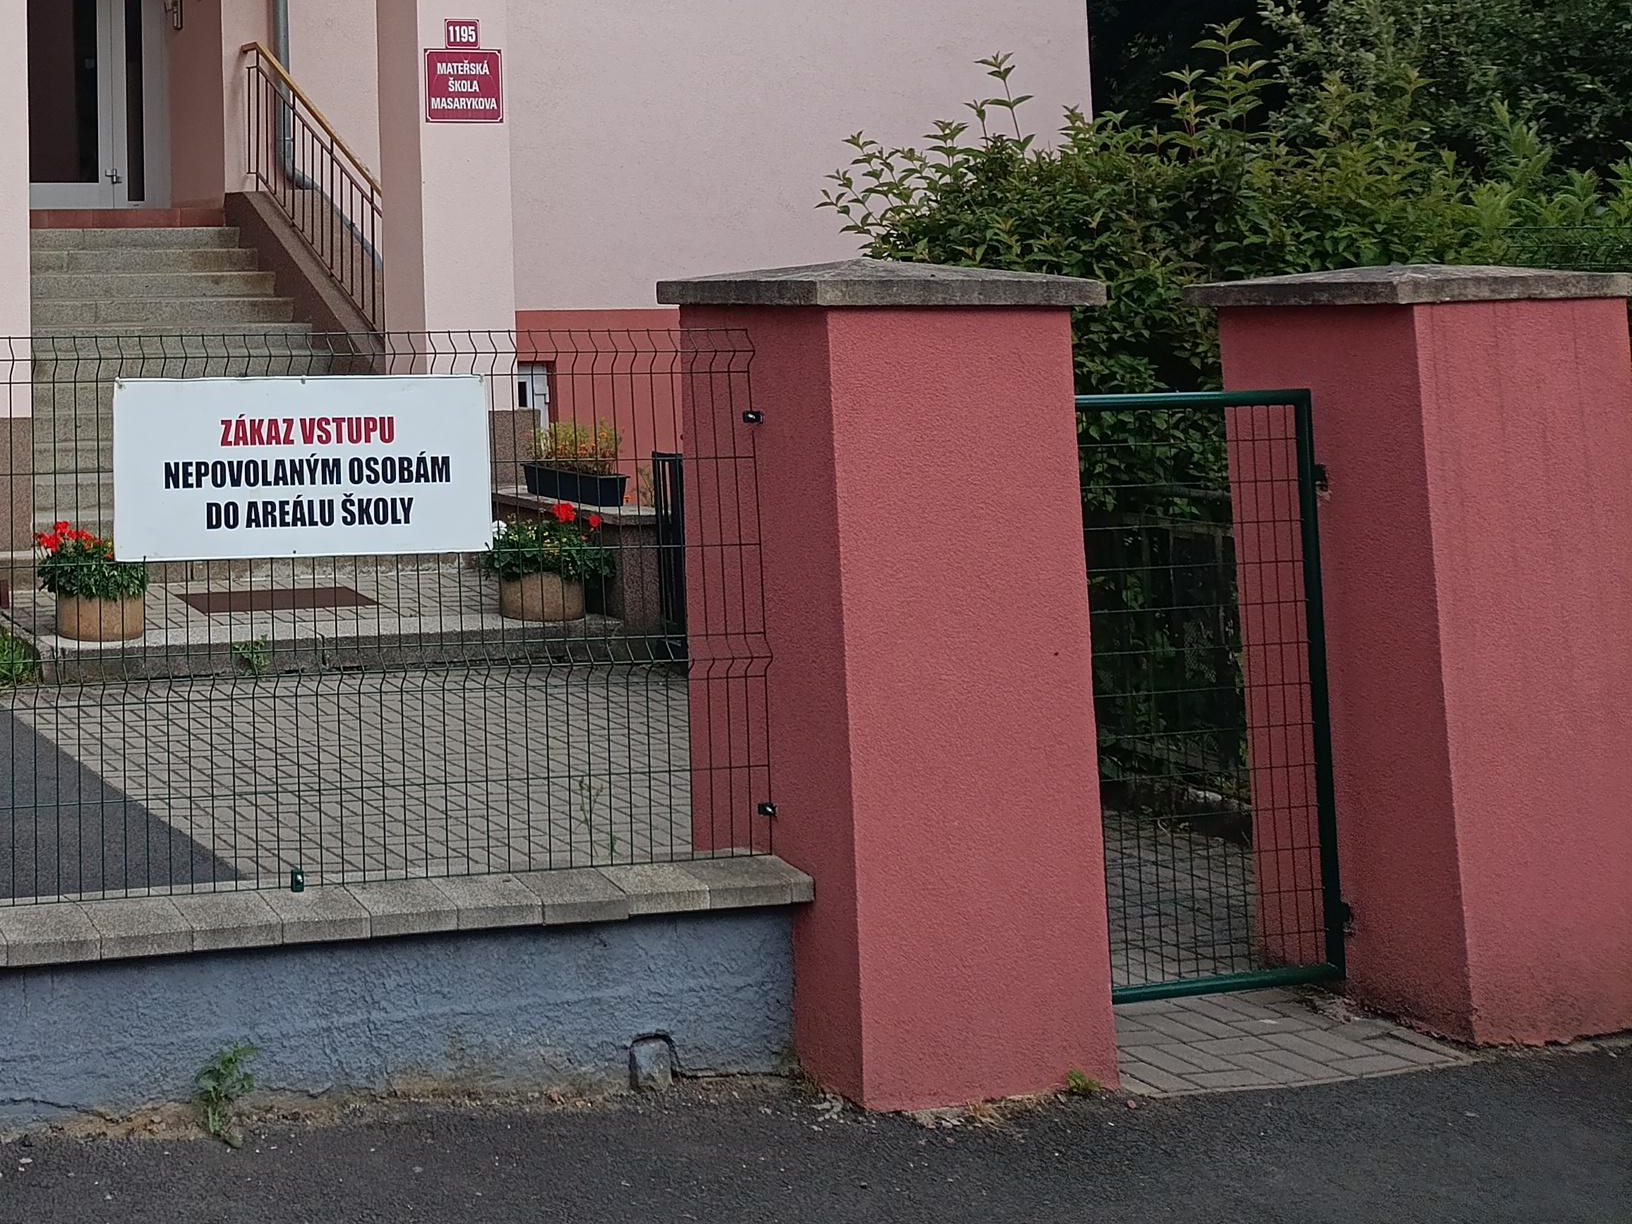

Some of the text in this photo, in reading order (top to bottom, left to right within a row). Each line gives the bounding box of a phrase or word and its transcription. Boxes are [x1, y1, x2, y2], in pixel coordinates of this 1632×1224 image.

[448, 25, 476, 43] 1195
[436, 60, 490, 75] MATEŘSKÁ
[448, 77, 480, 92] ŠKOLA
[431, 97, 498, 110] MASARYKOVA
[220, 413, 395, 447] ZÁKAZ VSTUPU
[164, 451, 451, 490] NEPOVOLANÝM OSOBÁM
[206, 492, 414, 530] DO AREÁLU ŠKOLY
